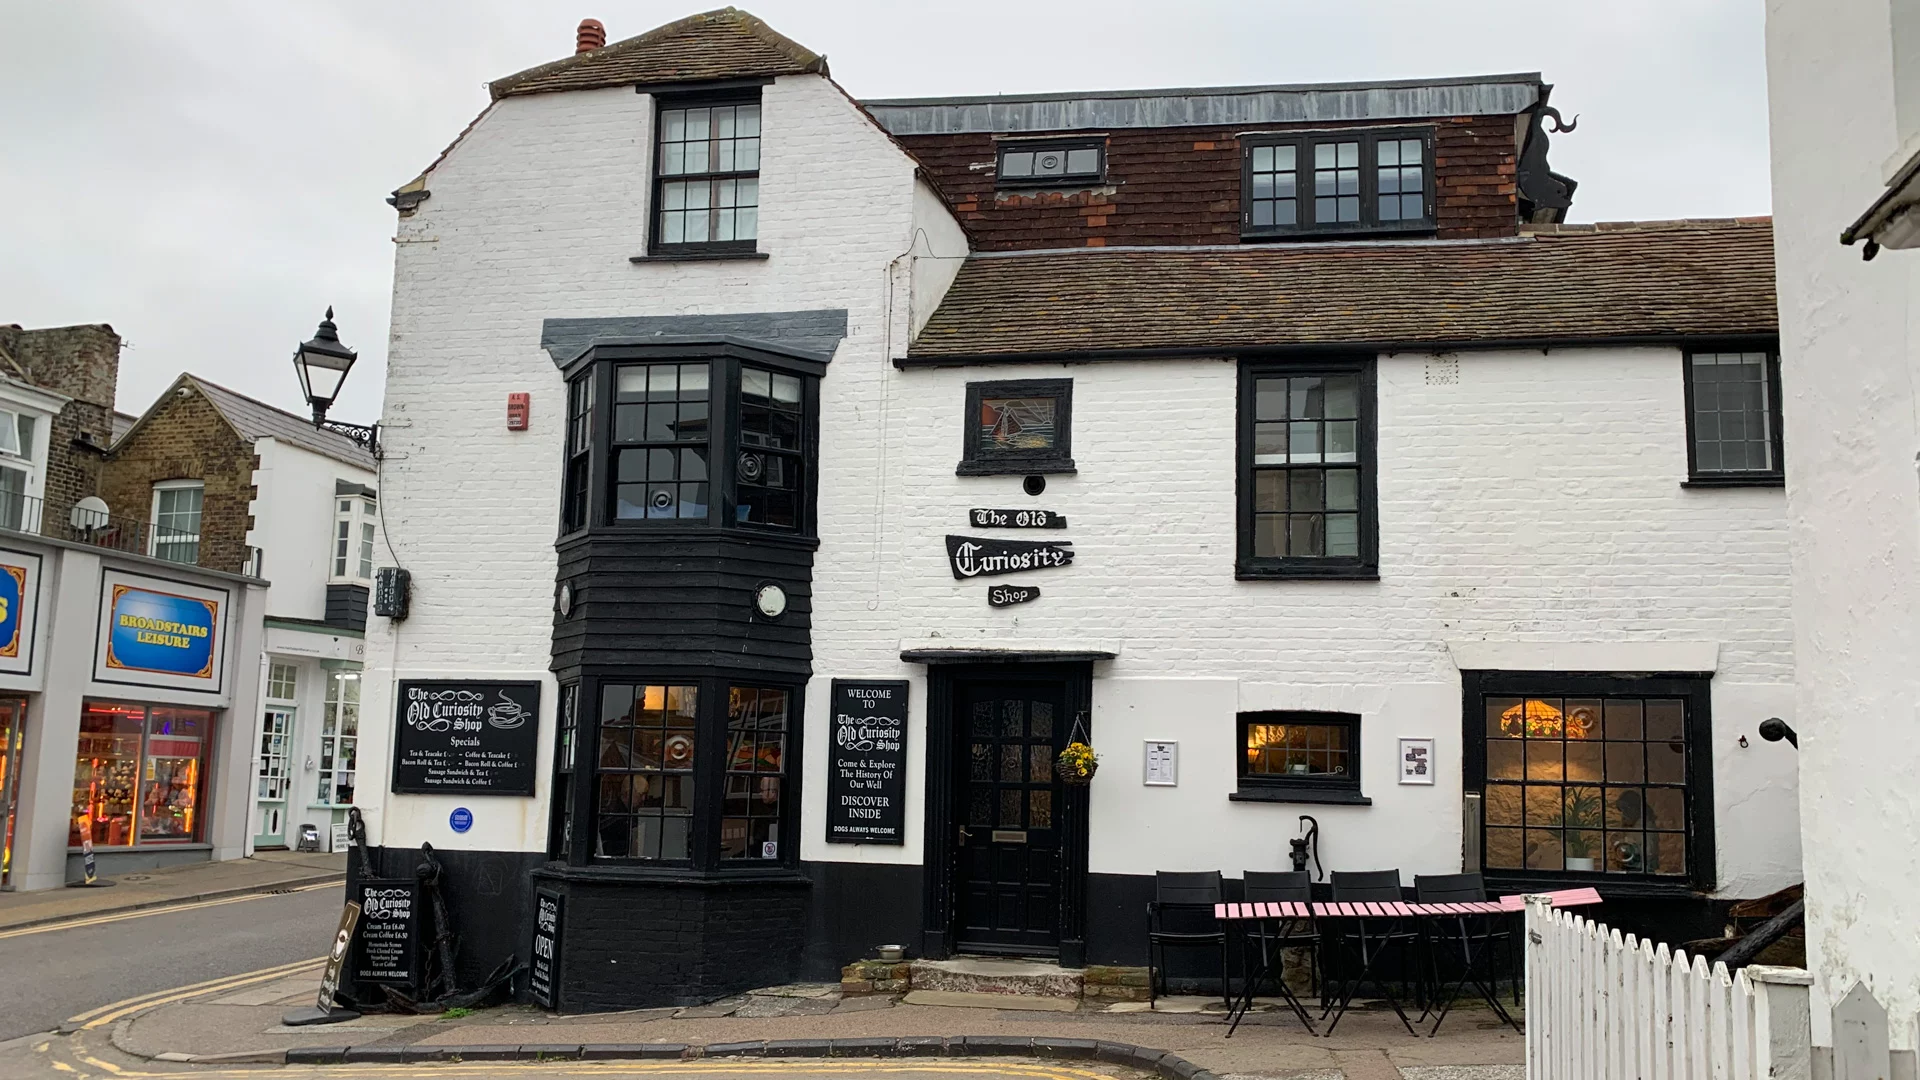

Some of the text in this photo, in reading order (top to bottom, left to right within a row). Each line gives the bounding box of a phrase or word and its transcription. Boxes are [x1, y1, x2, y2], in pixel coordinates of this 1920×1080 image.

[974, 510, 1046, 526] The Old
[956, 541, 1066, 576] Curiosity
[992, 589, 1028, 604] Shop
[120, 614, 208, 638] BROADSTAIRS
[137, 631, 190, 649] LEISURE
[408, 688, 429, 701] The
[848, 689, 891, 699] WELCOME
[863, 700, 875, 708] TO
[407, 701, 483, 726] Old Curiosity
[453, 718, 482, 732] Shop
[837, 714, 855, 726] The
[450, 736, 480, 746] Specials
[837, 725, 900, 746] Old Curiosity
[876, 740, 900, 751] Shop
[838, 759, 857, 768] Come
[869, 760, 895, 769] Explore
[840, 769, 893, 780] The History Of
[850, 780, 882, 789] Our Well
[841, 796, 889, 807] DISCOVER
[849, 808, 881, 819] INSIDE
[364, 888, 378, 898] The
[364, 897, 411, 915] Old Curiosity
[392, 909, 410, 919] Shop
[535, 934, 554, 959] OPEN
